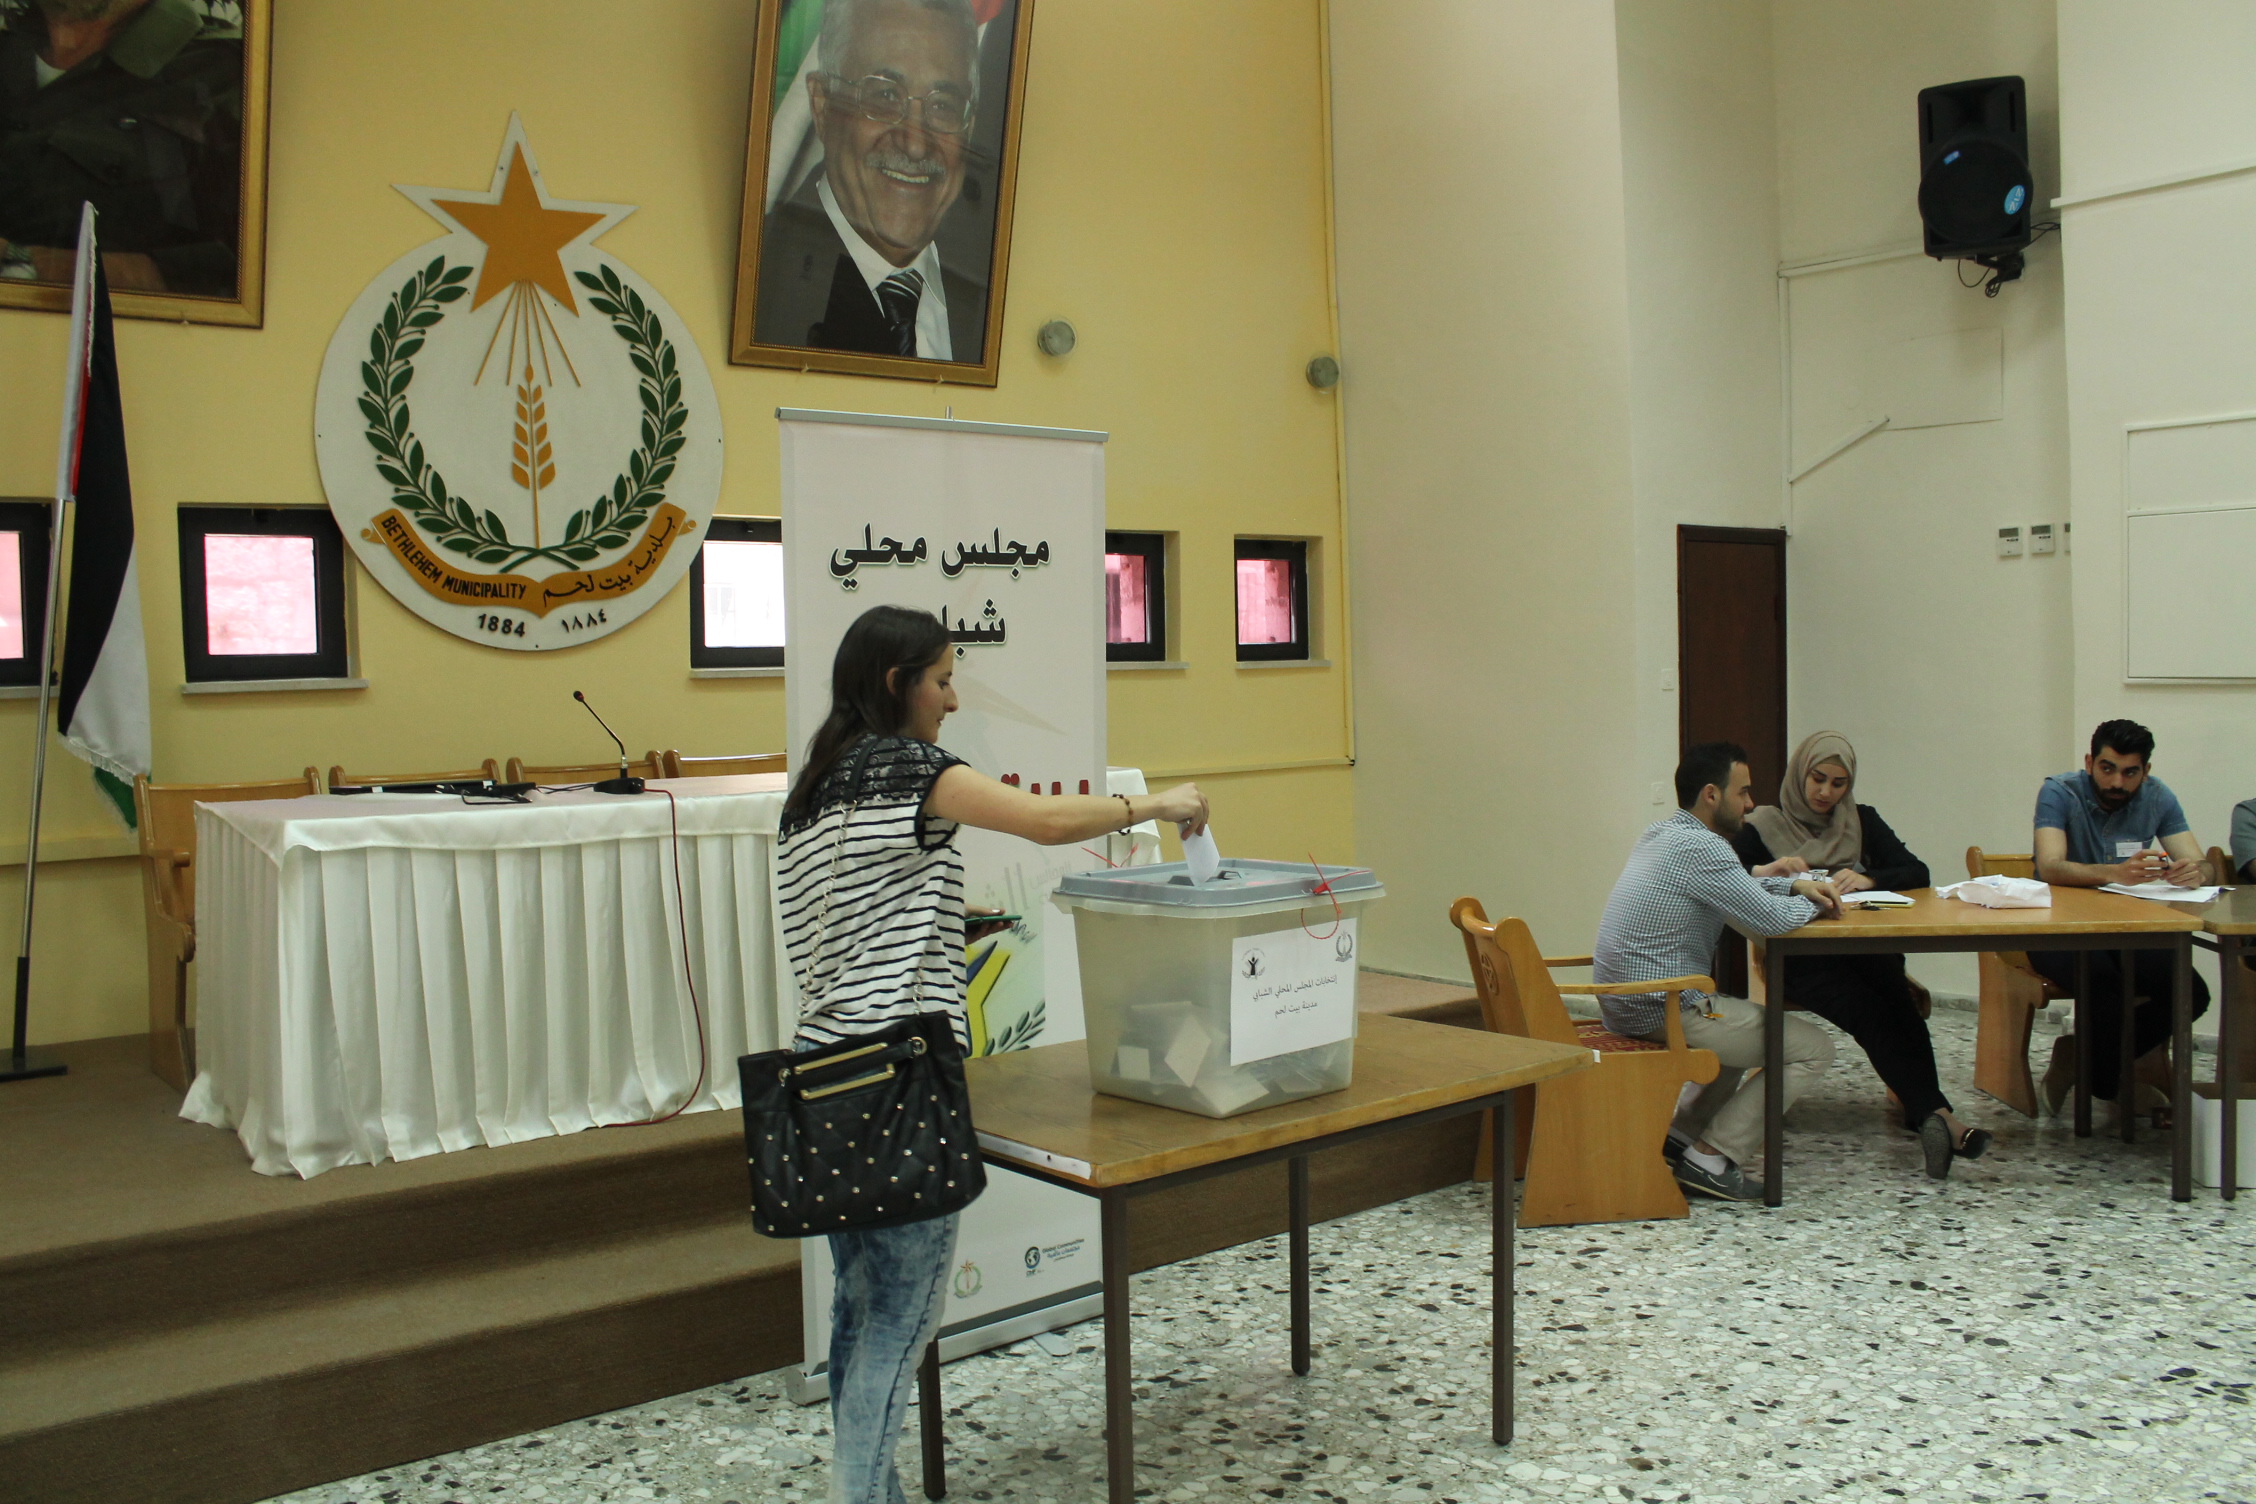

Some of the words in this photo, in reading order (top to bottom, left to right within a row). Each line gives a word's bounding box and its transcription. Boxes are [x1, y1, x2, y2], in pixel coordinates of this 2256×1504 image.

[381, 515, 443, 583] BETHLEHEM
[442, 575, 527, 600] MUNICIPALITY
[628, 516, 676, 575] بلدية
[829, 522, 928, 590] محلي
[940, 527, 1051, 579] مجلس
[543, 574, 595, 608] لحم
[599, 574, 633, 591] بيت
[478, 613, 526, 637] 1884
[562, 608, 607, 633] ١٨٨٤
[941, 598, 1008, 658] شبا
[1253, 987, 1272, 1002] الشبابي
[1275, 984, 1292, 998] المحلي
[1294, 980, 1313, 992] المجلس
[1275, 1006, 1286, 1018] لحم
[1288, 1004, 1301, 1013] بيت
[1302, 1001, 1318, 1011] مدينة
